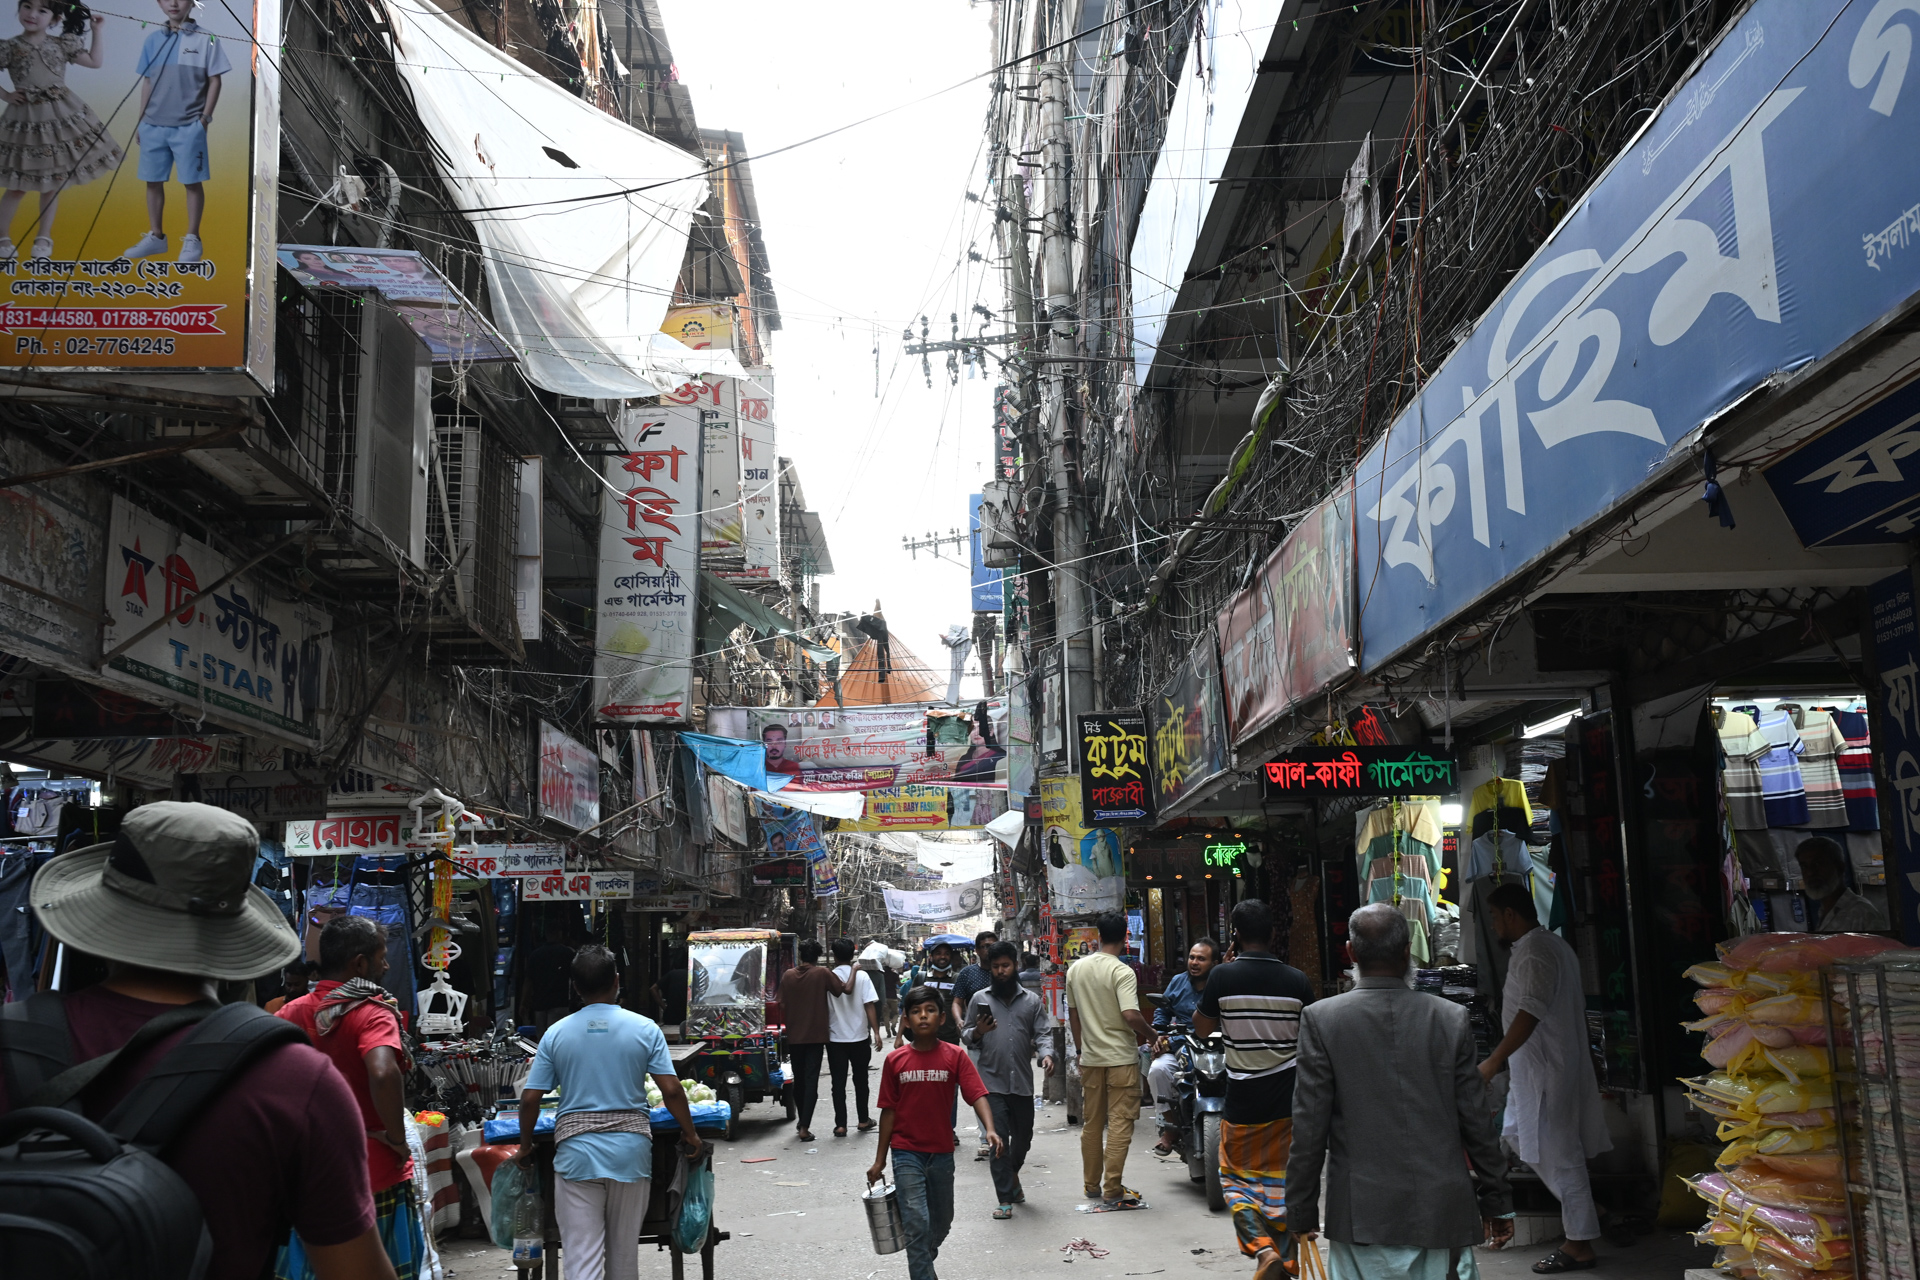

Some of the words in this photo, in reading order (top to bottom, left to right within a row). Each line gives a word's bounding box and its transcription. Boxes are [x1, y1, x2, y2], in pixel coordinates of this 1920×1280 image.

[22, 258, 76, 276] পরিষদ
[80, 257, 132, 276] মার্কেট
[11, 279, 68, 297] দোকান
[102, 311, 207, 327] 01788-760075
[1366, 86, 1807, 585] ফাহিম
[65, 337, 176, 355] 02-7764245
[627, 590, 686, 608] গার্মেন্টস
[126, 601, 143, 617] STAR
[212, 584, 281, 672] স্টার
[169, 638, 273, 703] T-STAR
[1084, 721, 1103, 734] নিউ
[1084, 721, 1147, 781] কুটুম
[1264, 751, 1363, 790] আল-কাফী
[1367, 751, 1453, 789] গার্মেন্টস
[873, 802, 902, 814] MUKTA
[903, 802, 919, 813] BABY
[313, 814, 401, 851] রোহান
[595, 877, 630, 890] গার্মেন্টস
